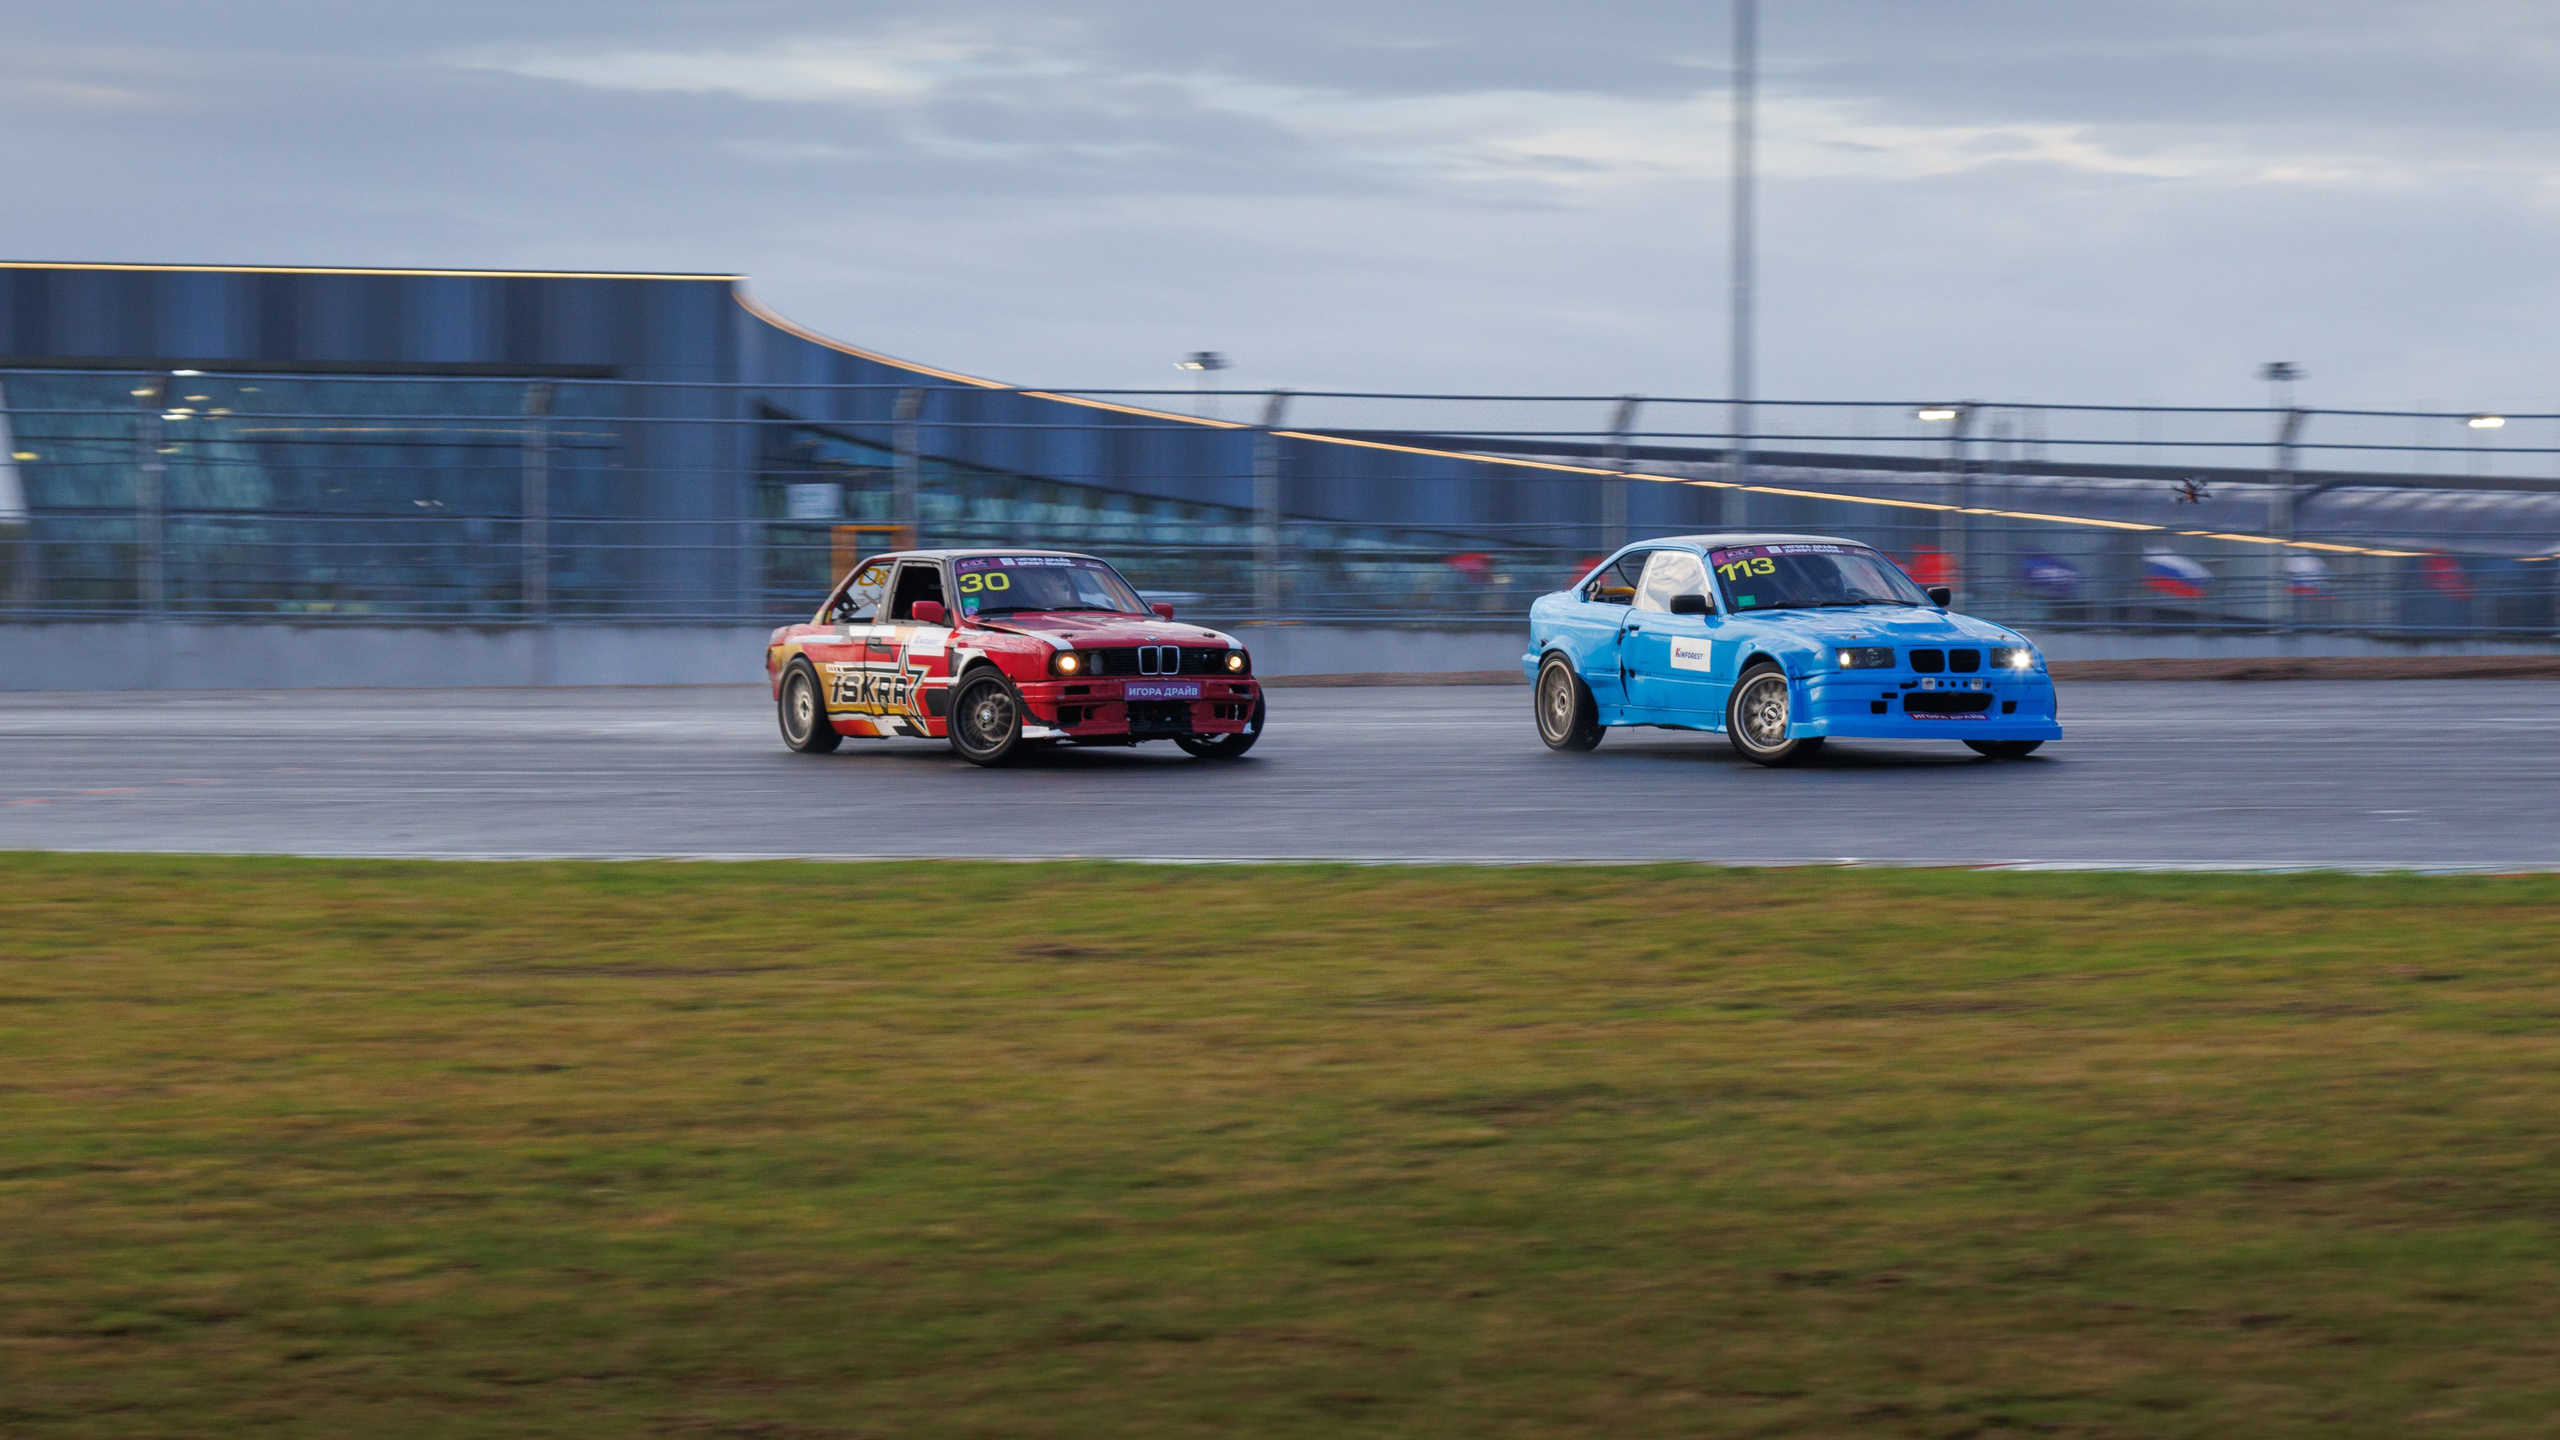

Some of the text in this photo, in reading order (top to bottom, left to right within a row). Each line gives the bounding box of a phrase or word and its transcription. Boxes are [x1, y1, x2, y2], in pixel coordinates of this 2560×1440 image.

[1717, 557, 1776, 582] 113
[960, 572, 1010, 593] 30
[1675, 647, 1704, 660] KINFOREST
[1128, 685, 1198, 697] ИГОРА ДРАЙВ
